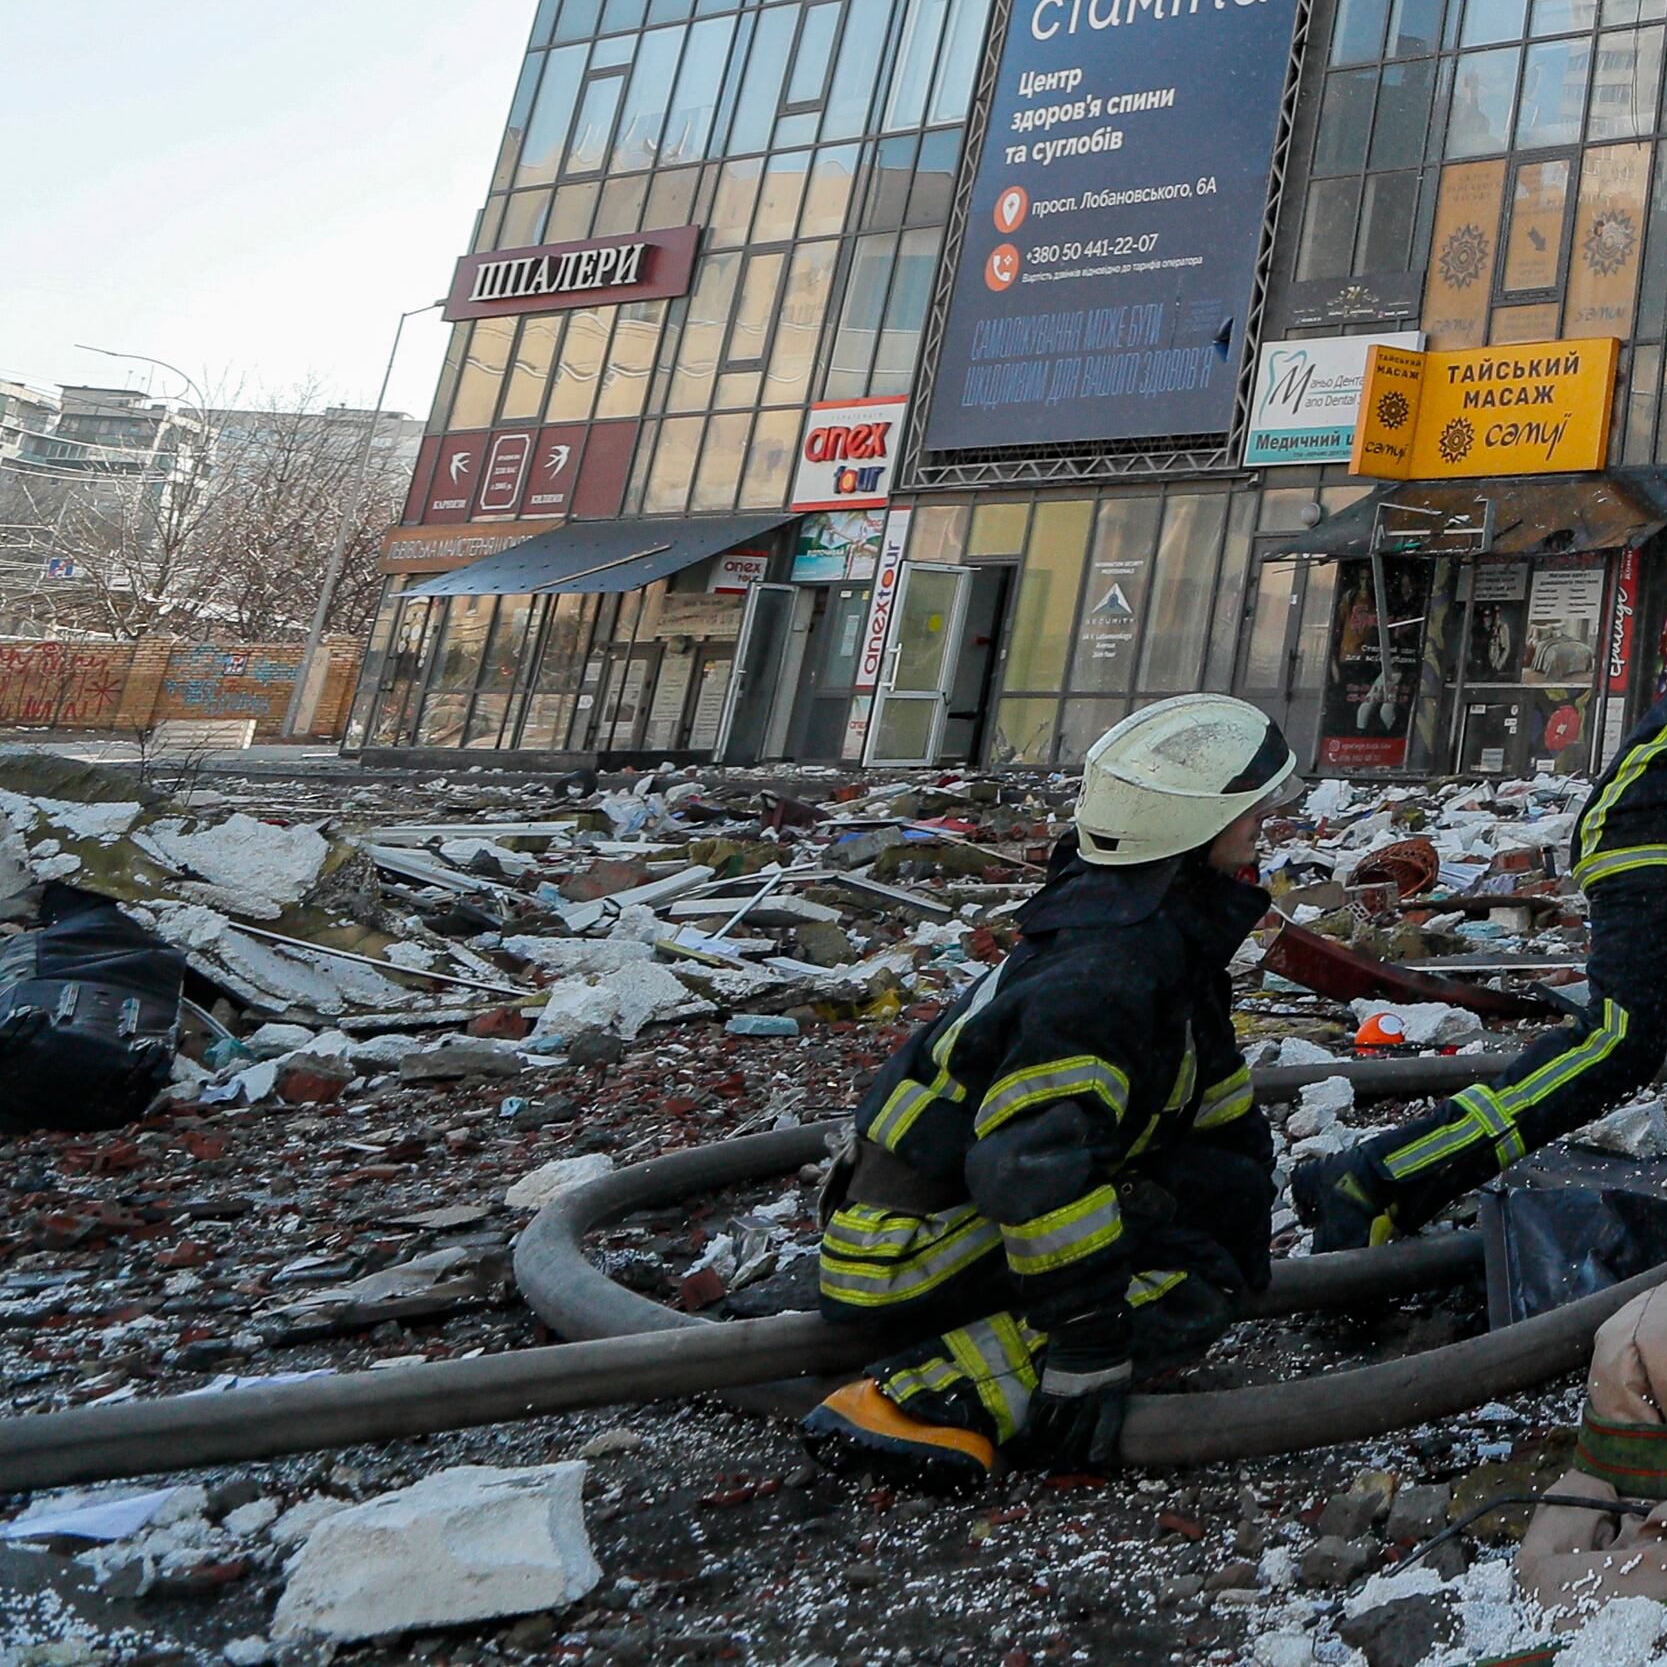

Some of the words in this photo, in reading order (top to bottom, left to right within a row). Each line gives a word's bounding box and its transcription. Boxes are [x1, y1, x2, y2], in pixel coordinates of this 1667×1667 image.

[1018, 67, 1083, 96] Центр
[1011, 93, 1102, 132] здоров'я
[1107, 87, 1175, 115] спини
[1005, 145, 1027, 164] та
[1032, 127, 1124, 165] суглобів
[1032, 195, 1078, 216] просп.
[1080, 182, 1193, 210] Лобановського,
[1026, 242, 1058, 264] +380
[1062, 240, 1081, 259] 50
[1084, 233, 1158, 258] 441-22-07
[468, 242, 646, 302] ШПАЛЕРИ
[1083, 306, 1129, 349] МОЖЕ
[1128, 302, 1164, 347] БУТИ
[1376, 364, 1421, 381] МАСАЖ
[1378, 353, 1422, 367] ТАЙСЬКИЙ
[1448, 351, 1580, 384] ТАЙСЬКИЙ
[1046, 356, 1081, 405] ДЛЯ
[1081, 352, 1140, 400] ВАШОГО
[1325, 392, 1358, 407] Dental
[1463, 385, 1555, 409] МАСАЖ
[804, 421, 892, 463] anex
[1256, 433, 1345, 453] Медичний
[1484, 413, 1572, 461] самуї
[833, 465, 885, 494] tour
[387, 540, 436, 560] ЛЬВІВСЬКА
[438, 536, 496, 558] МАЙСТЕРНЯ
[724, 560, 761, 574] anex
